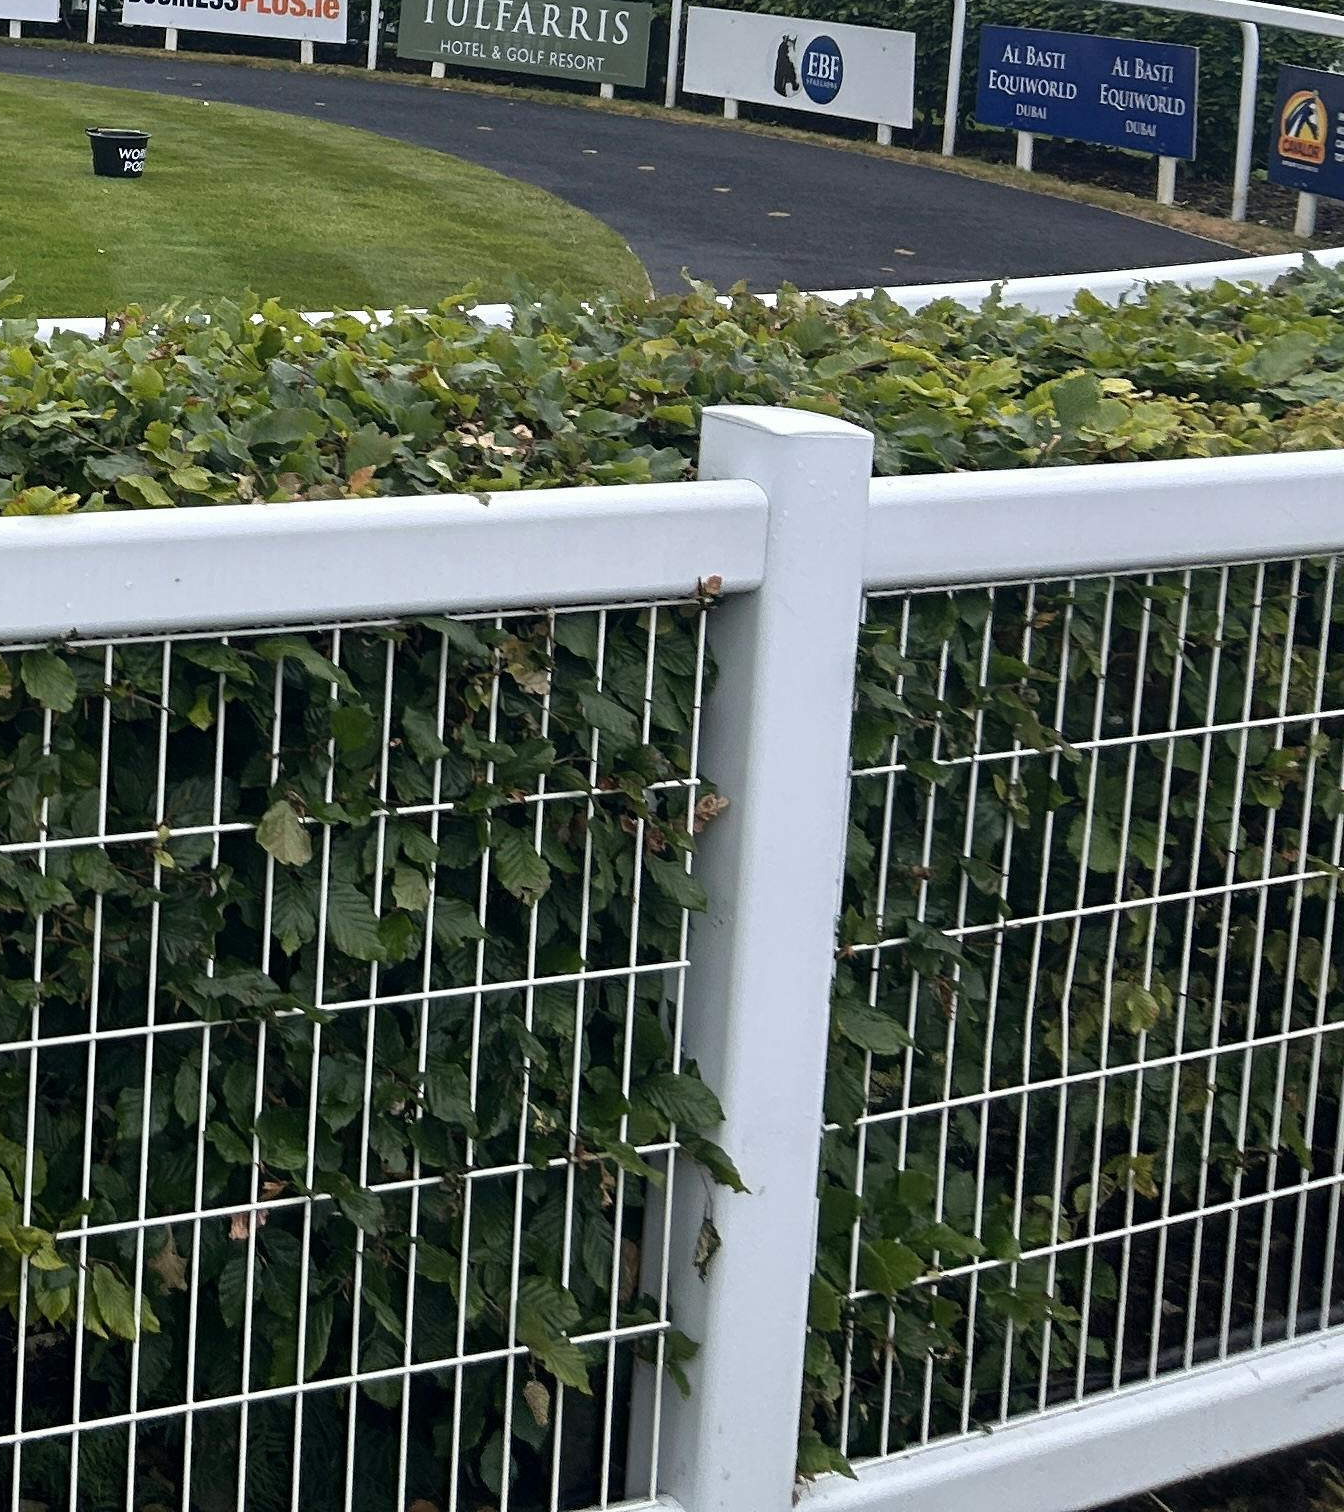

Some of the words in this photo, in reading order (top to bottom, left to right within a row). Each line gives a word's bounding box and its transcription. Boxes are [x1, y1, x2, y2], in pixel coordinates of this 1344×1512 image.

[440, 39, 487, 58] HOTEL
[491, 45, 501, 60] &
[506, 47, 545, 65] GOLF
[549, 51, 605, 72] RESORT
[807, 51, 840, 81] EBF
[1025, 45, 1067, 70] BASTI
[988, 69, 1078, 100] EQUIWORLD
[1134, 57, 1175, 84] BASTI
[1016, 103, 1047, 120] DUBAI
[1099, 83, 1186, 116] EQUIWORLD
[1126, 120, 1157, 137] DUBAI
